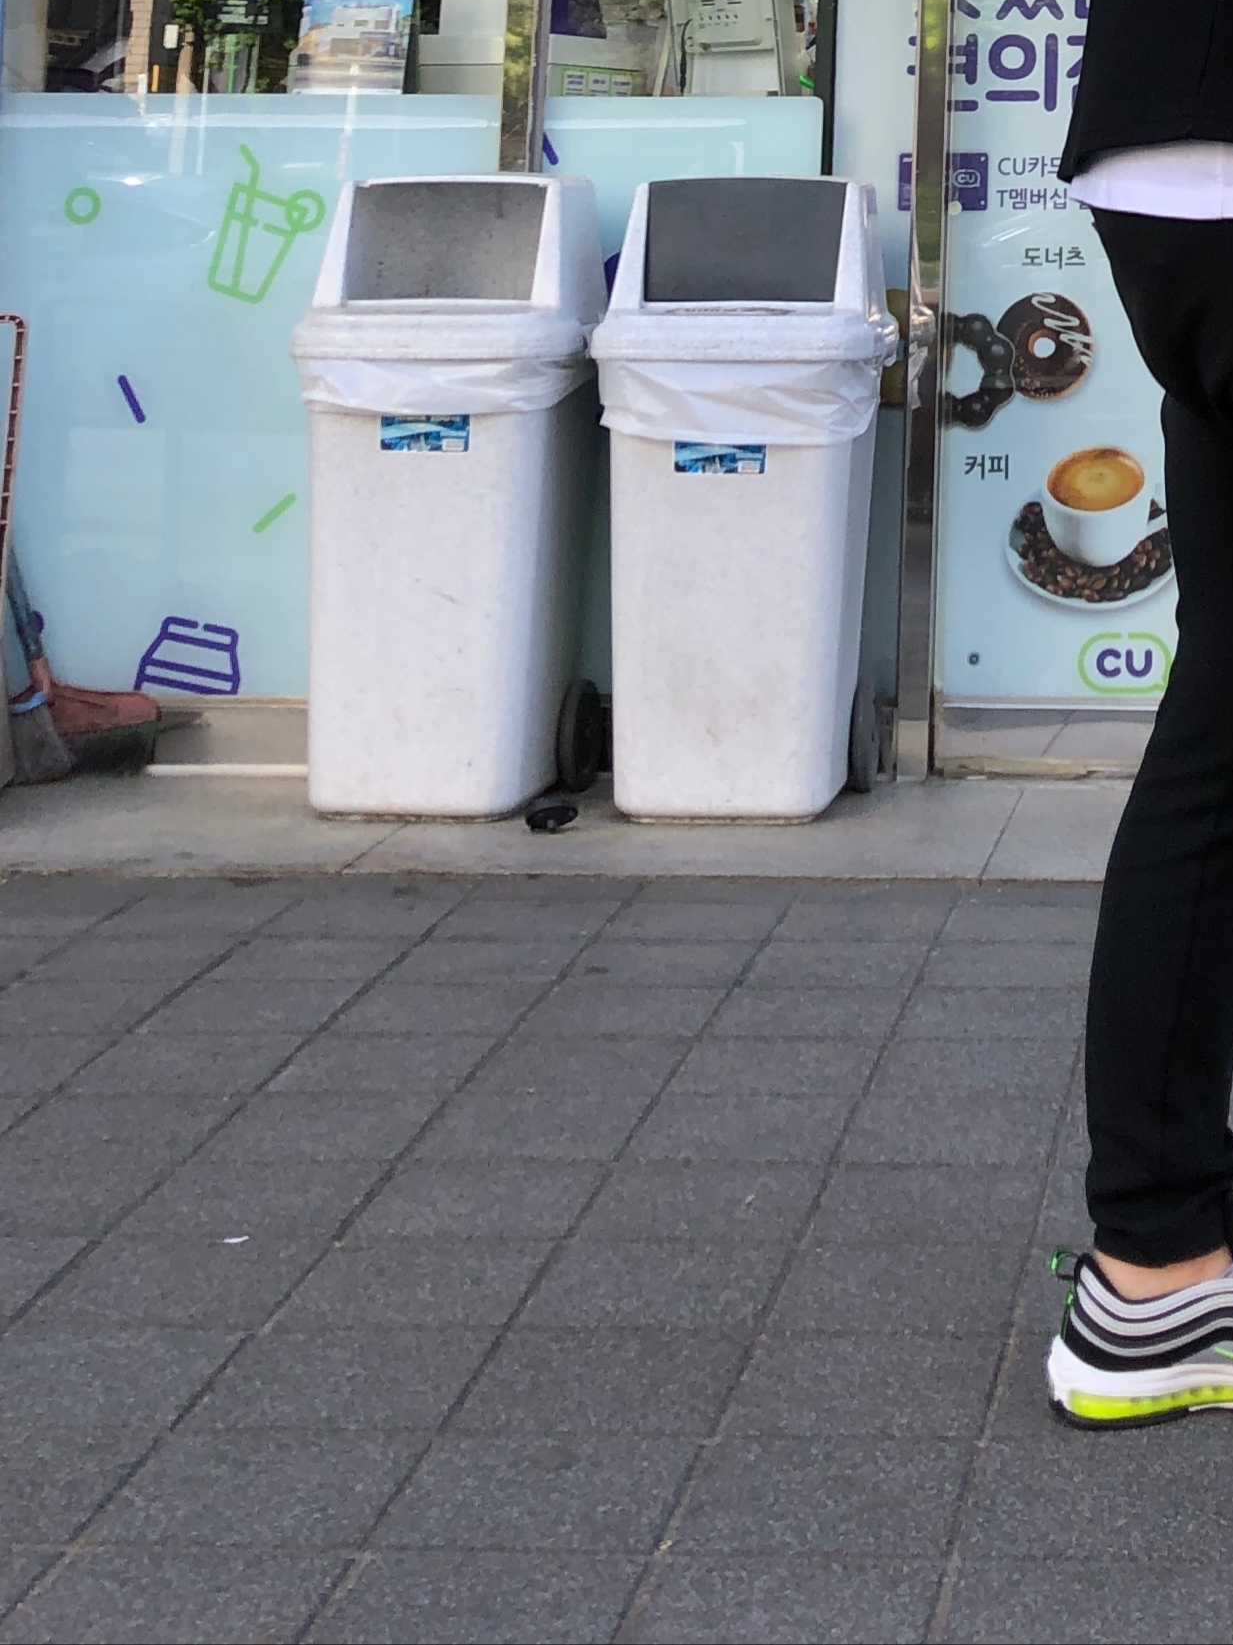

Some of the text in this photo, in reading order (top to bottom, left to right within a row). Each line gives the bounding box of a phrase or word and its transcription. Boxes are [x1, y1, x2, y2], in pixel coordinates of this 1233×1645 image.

[957, 171, 979, 185] CU
[997, 188, 1069, 210] T멤버십
[1022, 248, 1086, 269] 도너츠
[964, 454, 1010, 480] 커피
[1096, 648, 1153, 678] CU
